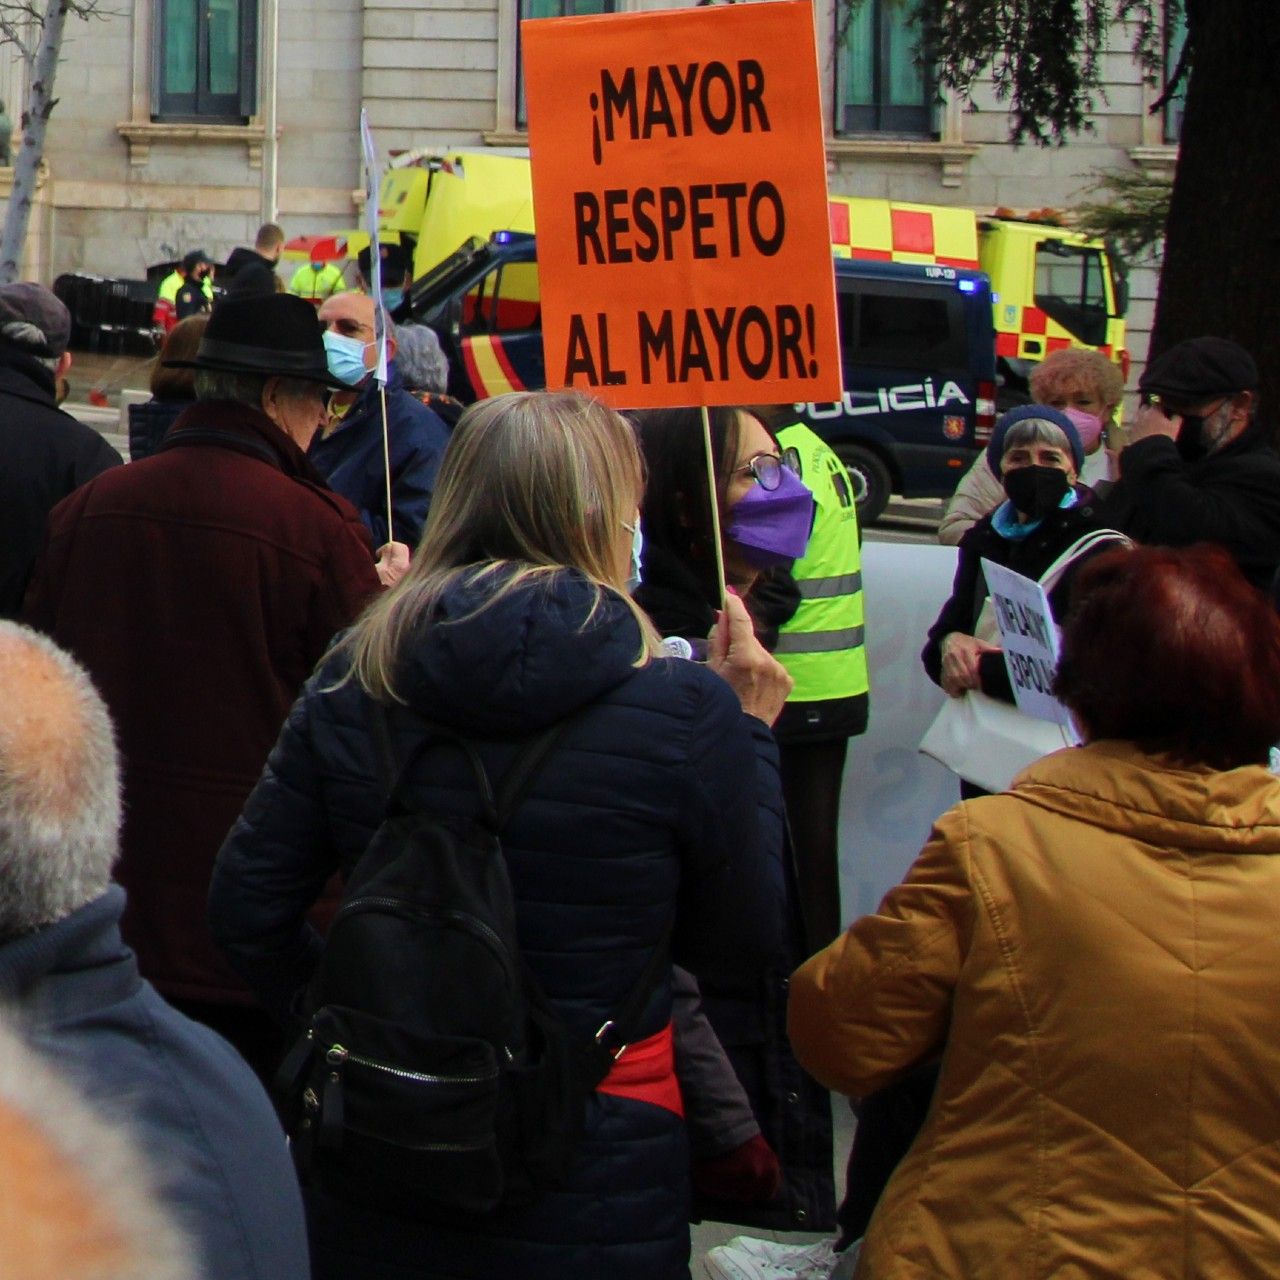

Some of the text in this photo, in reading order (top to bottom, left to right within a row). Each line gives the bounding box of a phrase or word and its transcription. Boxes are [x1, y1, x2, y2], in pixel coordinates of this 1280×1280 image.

[589, 59, 772, 166] ¡MAYOR
[573, 180, 786, 266] RESPETO
[564, 303, 820, 388] AL MAYOR!
